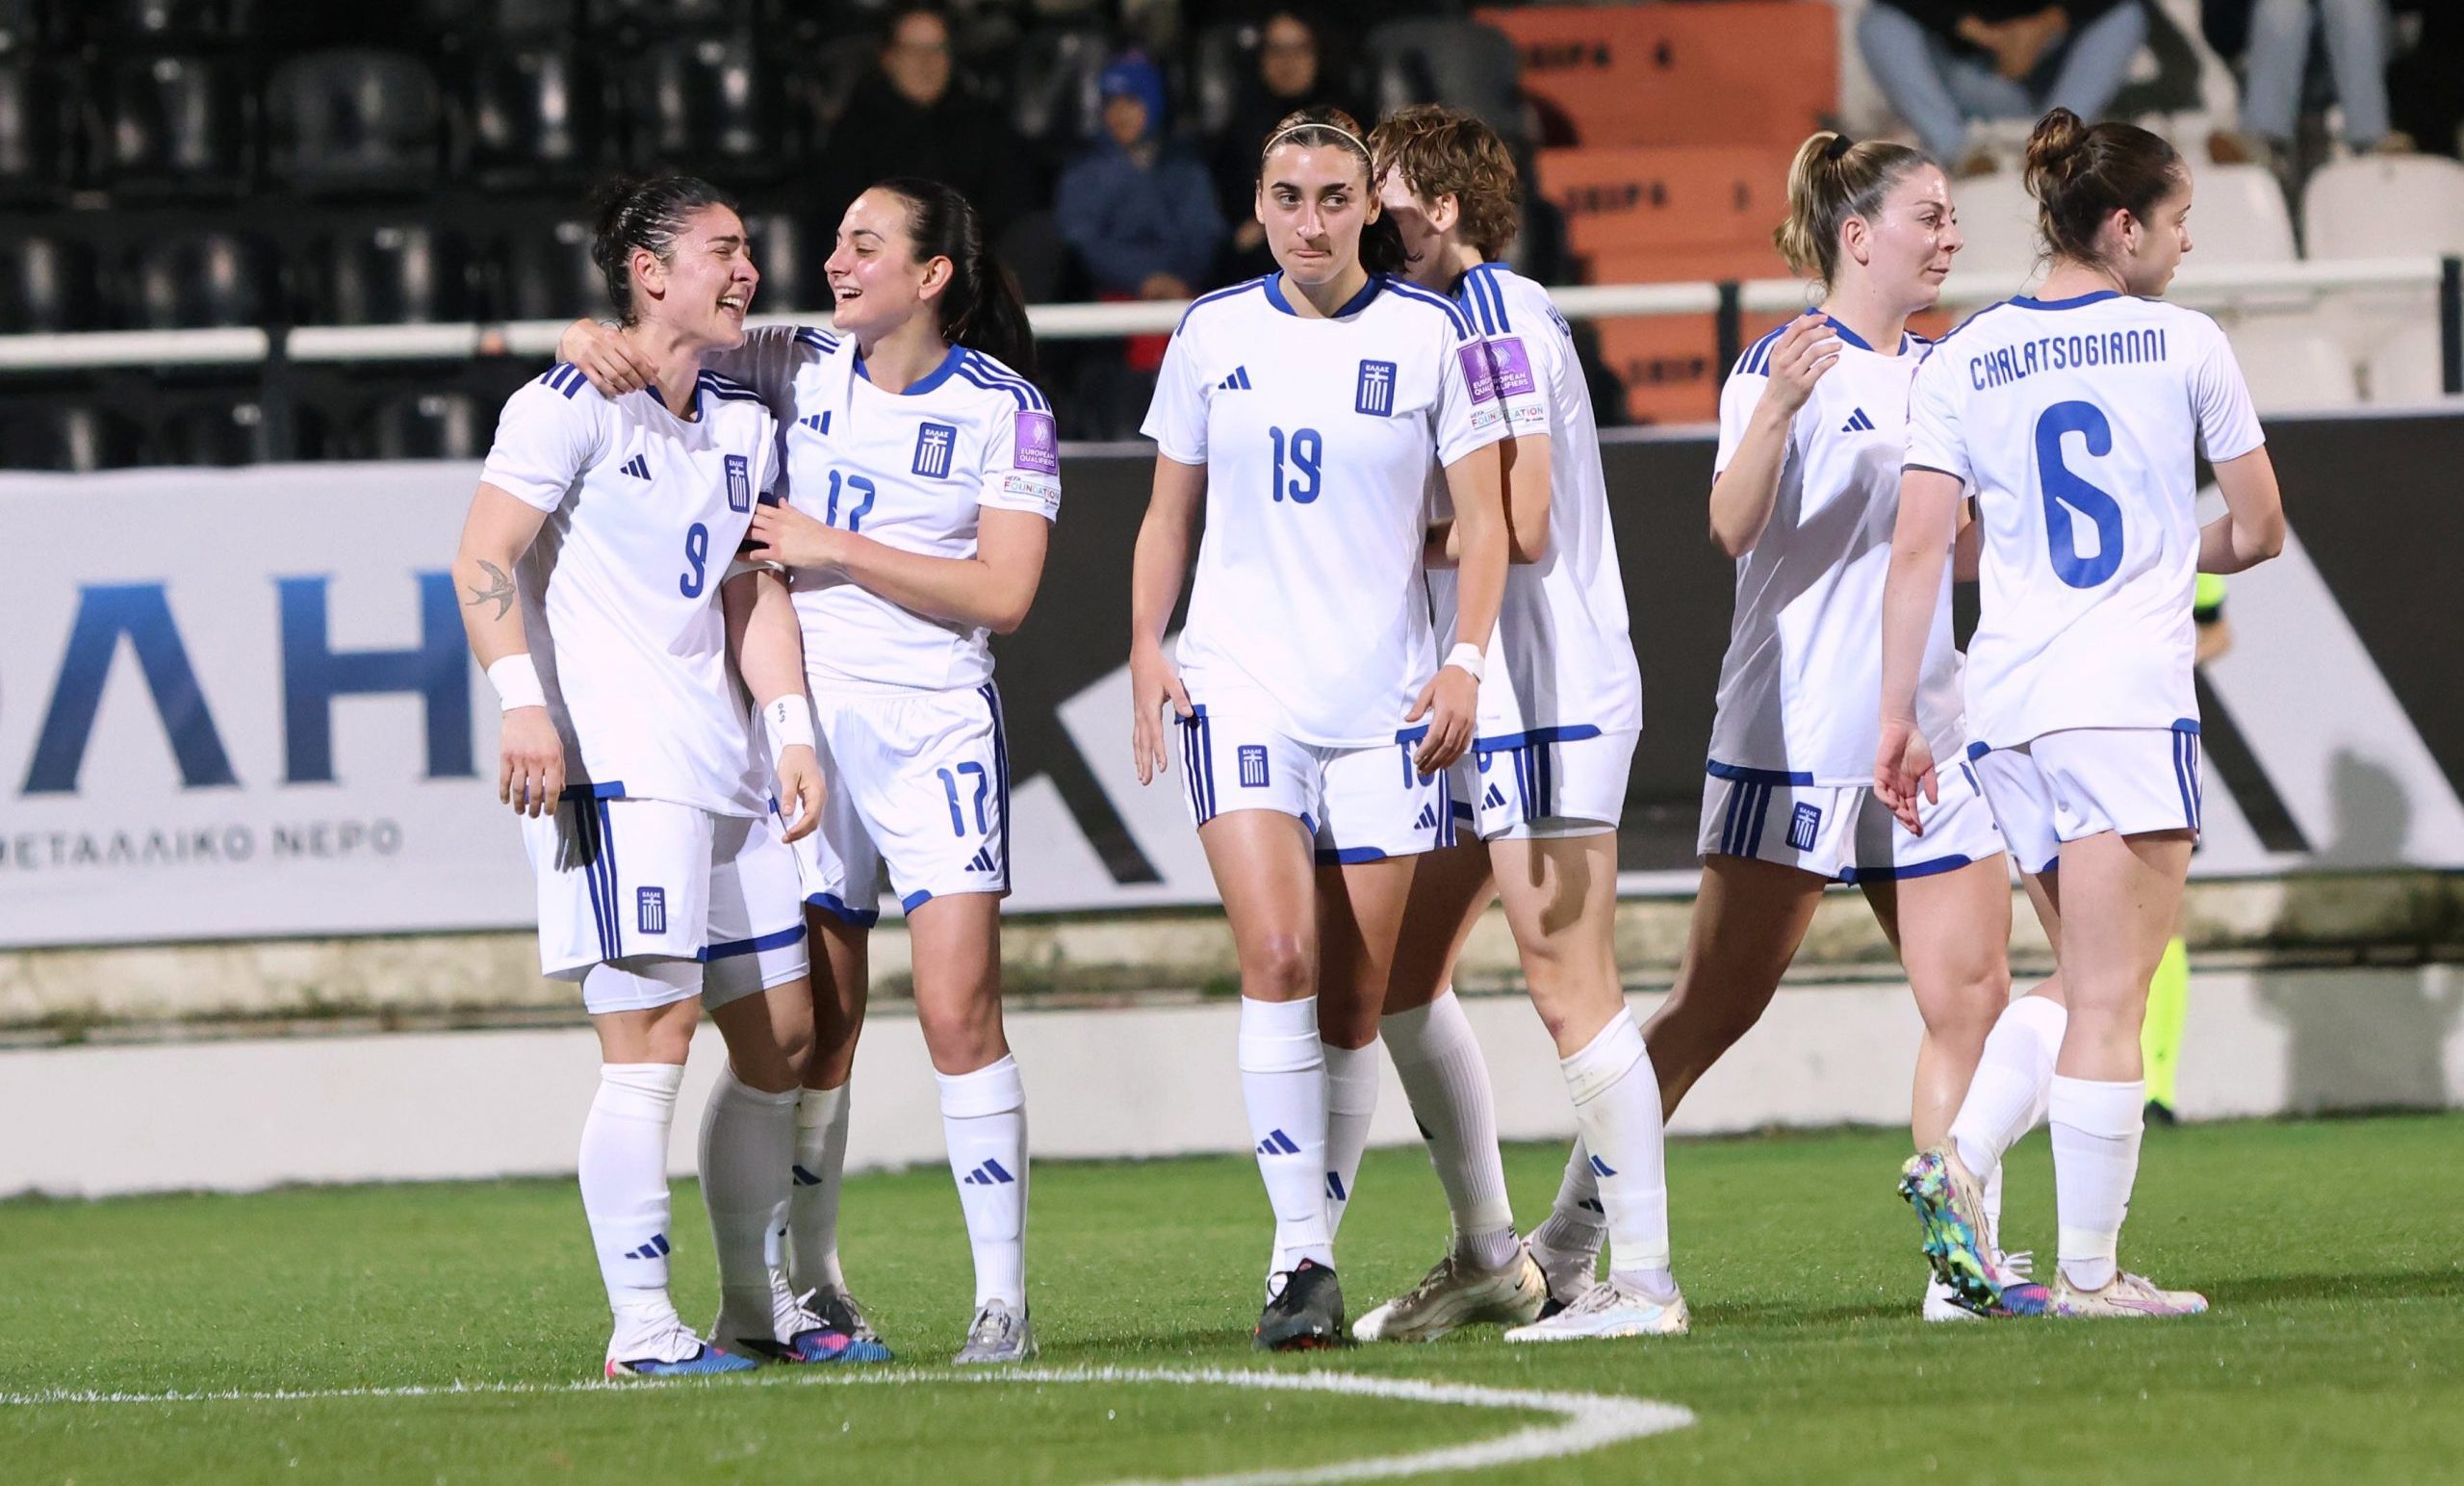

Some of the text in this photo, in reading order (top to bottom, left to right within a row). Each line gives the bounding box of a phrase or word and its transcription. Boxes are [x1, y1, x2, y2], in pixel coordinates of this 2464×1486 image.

[1970, 328, 2167, 391] CHALATSOGIANNI
[825, 469, 876, 534] 17
[1269, 425, 1322, 504] 19
[2036, 400, 2124, 589] 6
[680, 523, 709, 600] 9
[0, 568, 482, 797] ΛΗ
[937, 761, 988, 837] 17
[0, 817, 403, 868] ΕΤΑΛΛΙΚΟ ΝΕΡΟ
